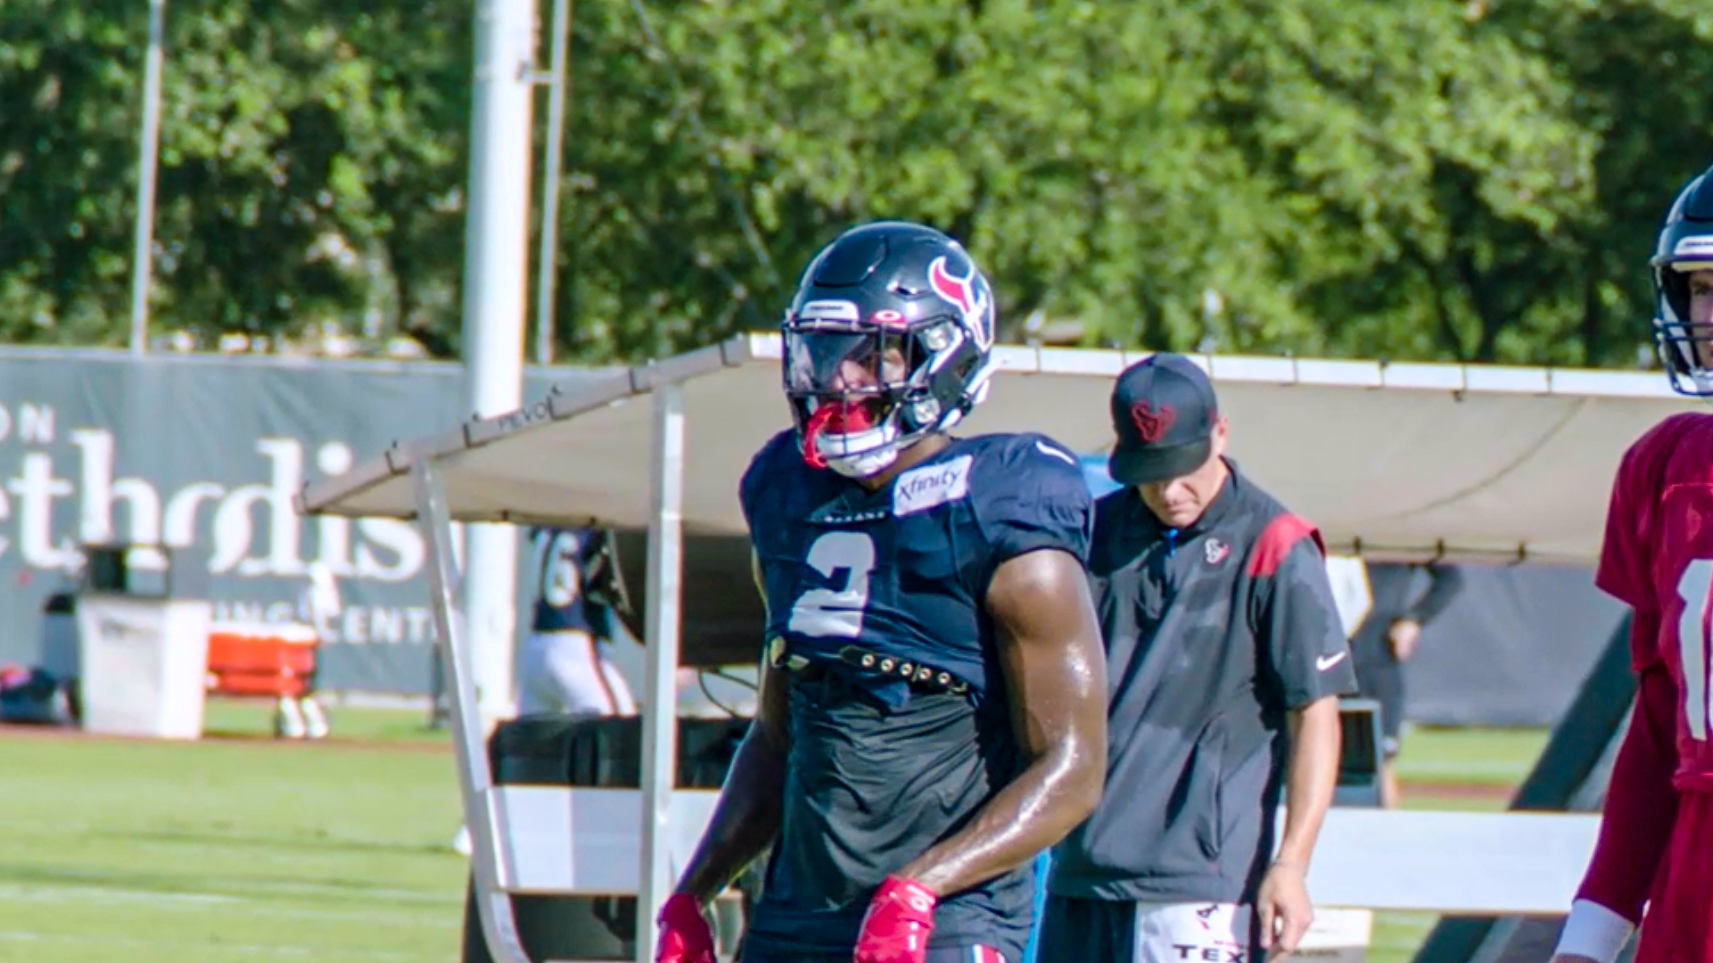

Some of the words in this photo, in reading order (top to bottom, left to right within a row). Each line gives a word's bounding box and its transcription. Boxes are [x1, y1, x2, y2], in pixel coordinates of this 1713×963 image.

[899, 470, 962, 500] xfinity
[788, 531, 876, 638] 2
[314, 605, 438, 645] CENT
